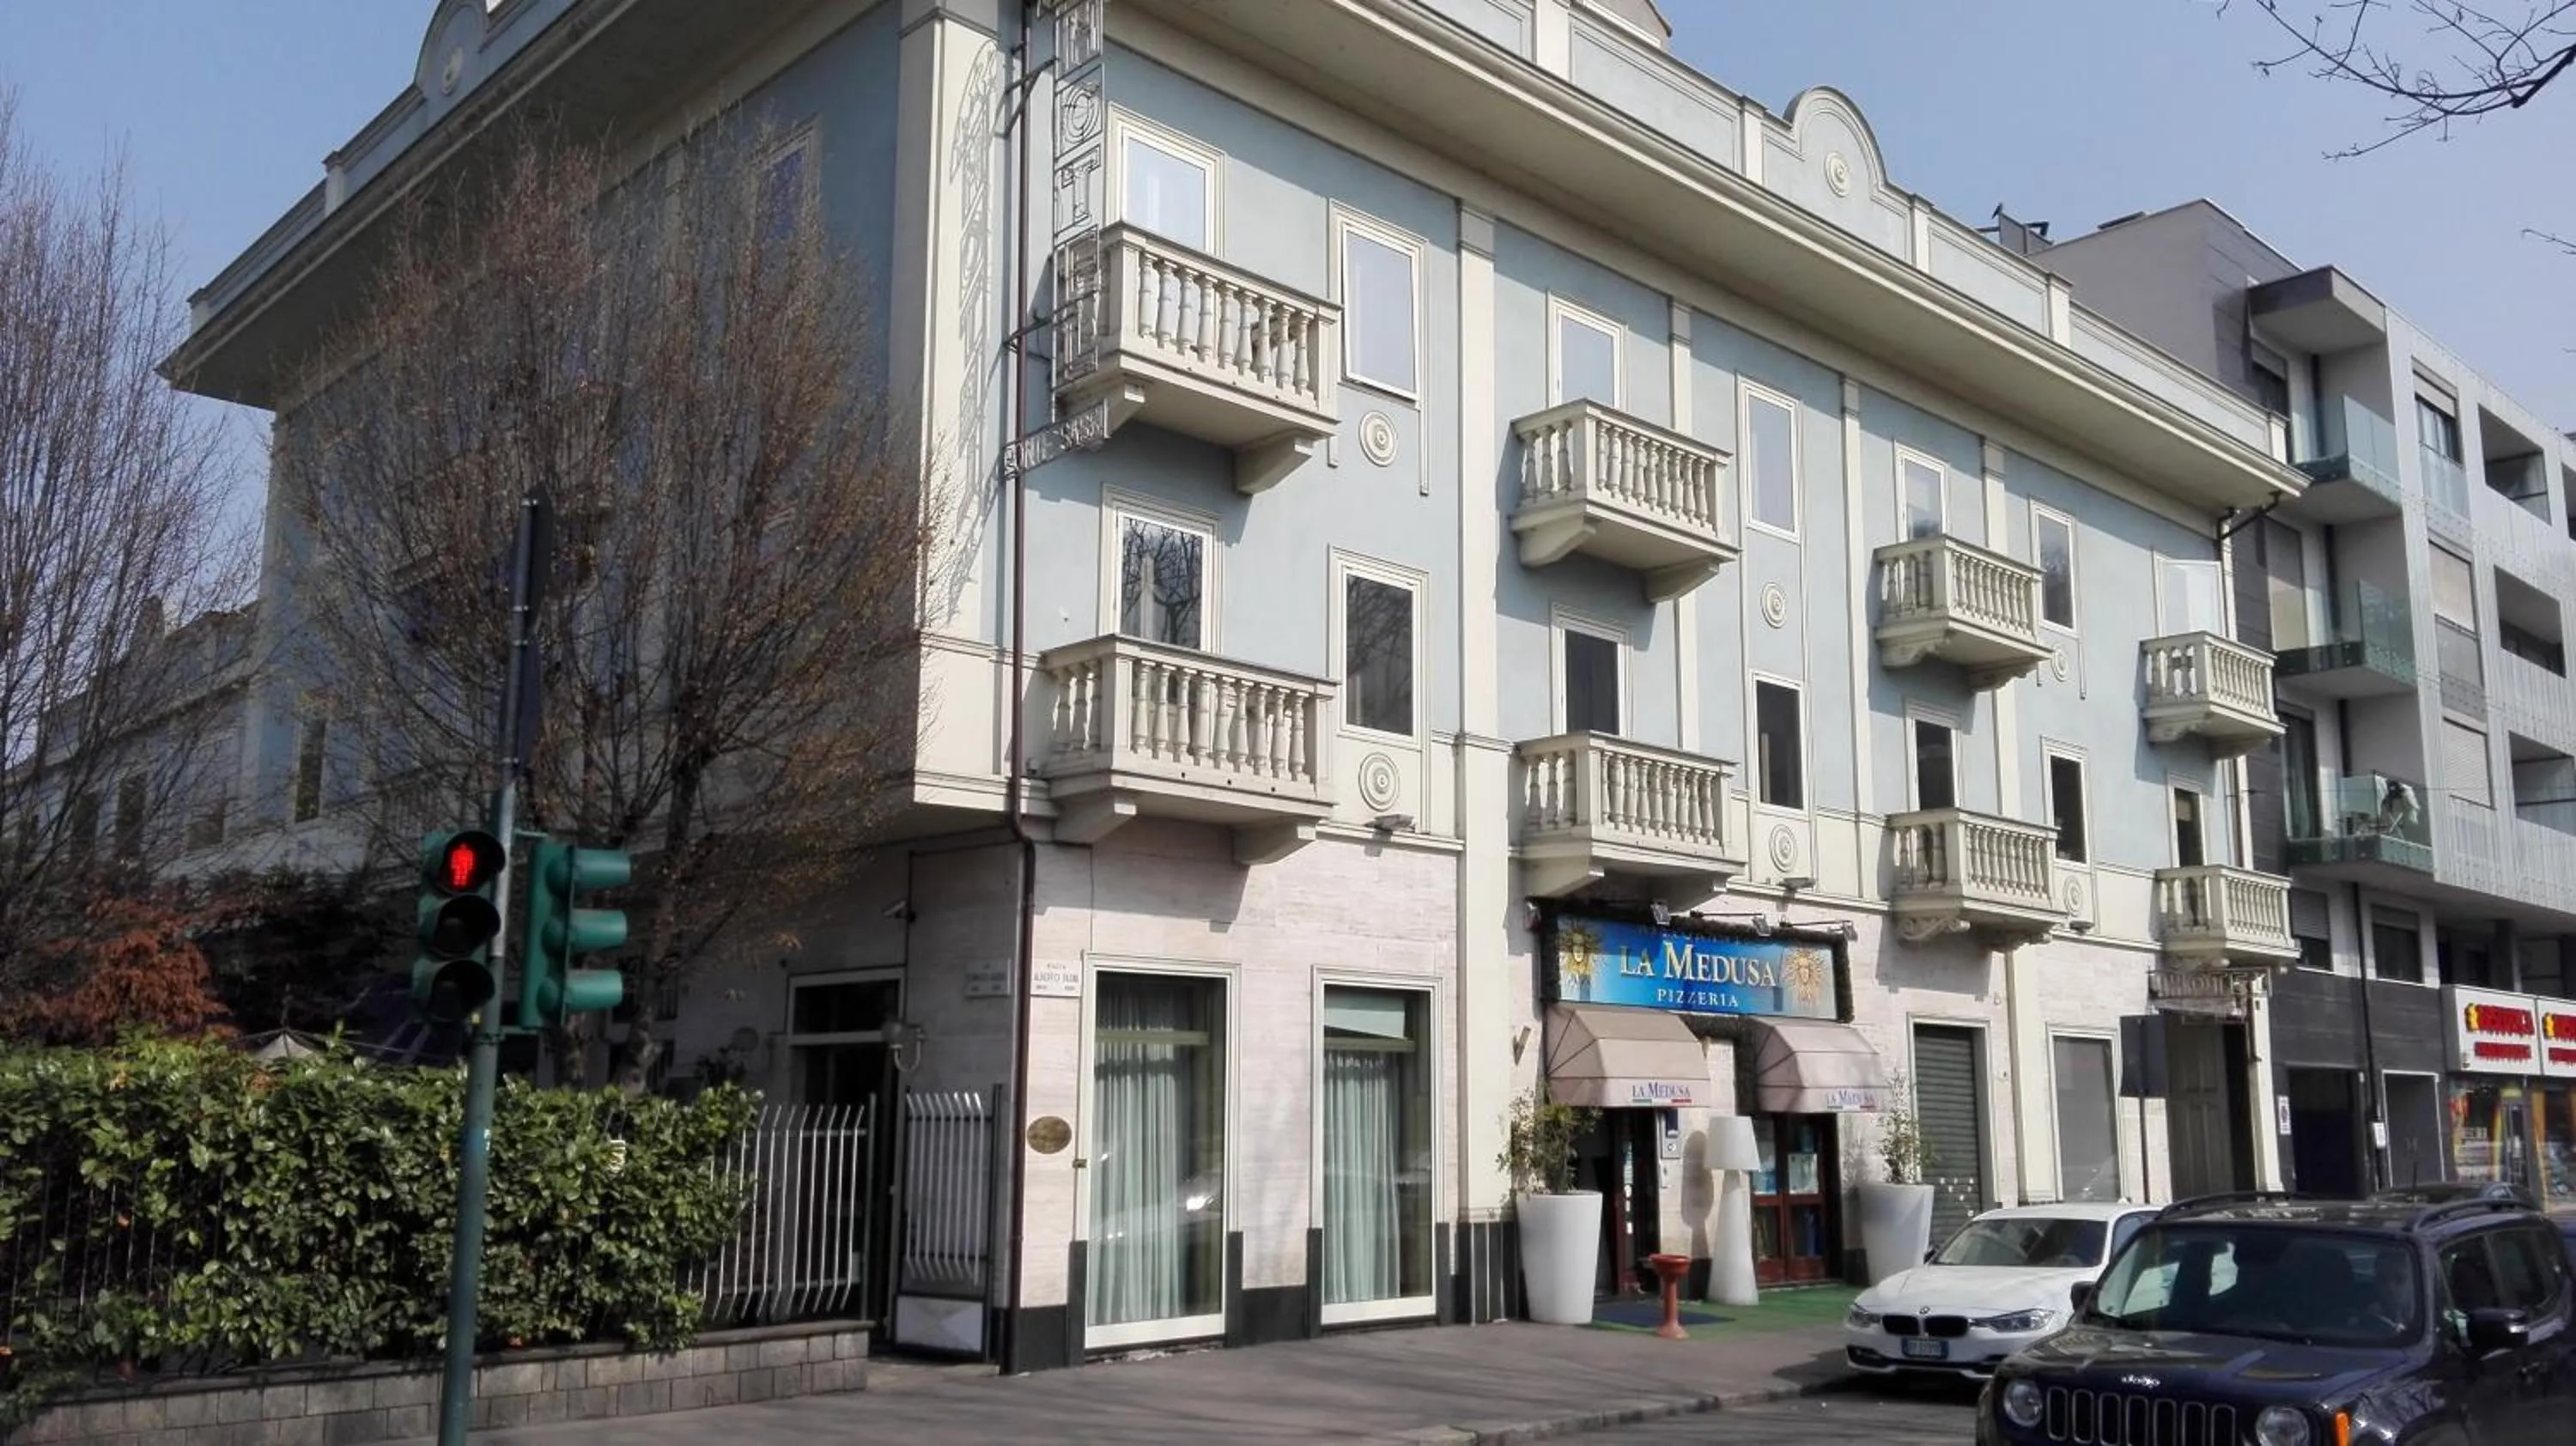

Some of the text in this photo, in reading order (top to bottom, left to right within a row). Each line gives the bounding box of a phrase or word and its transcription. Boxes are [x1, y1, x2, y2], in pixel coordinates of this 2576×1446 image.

[1620, 939, 1777, 987] LA MEDUSA
[1657, 988, 1739, 1006] PIZZERIA
[1632, 1081, 1691, 1098] LA MEDUSA
